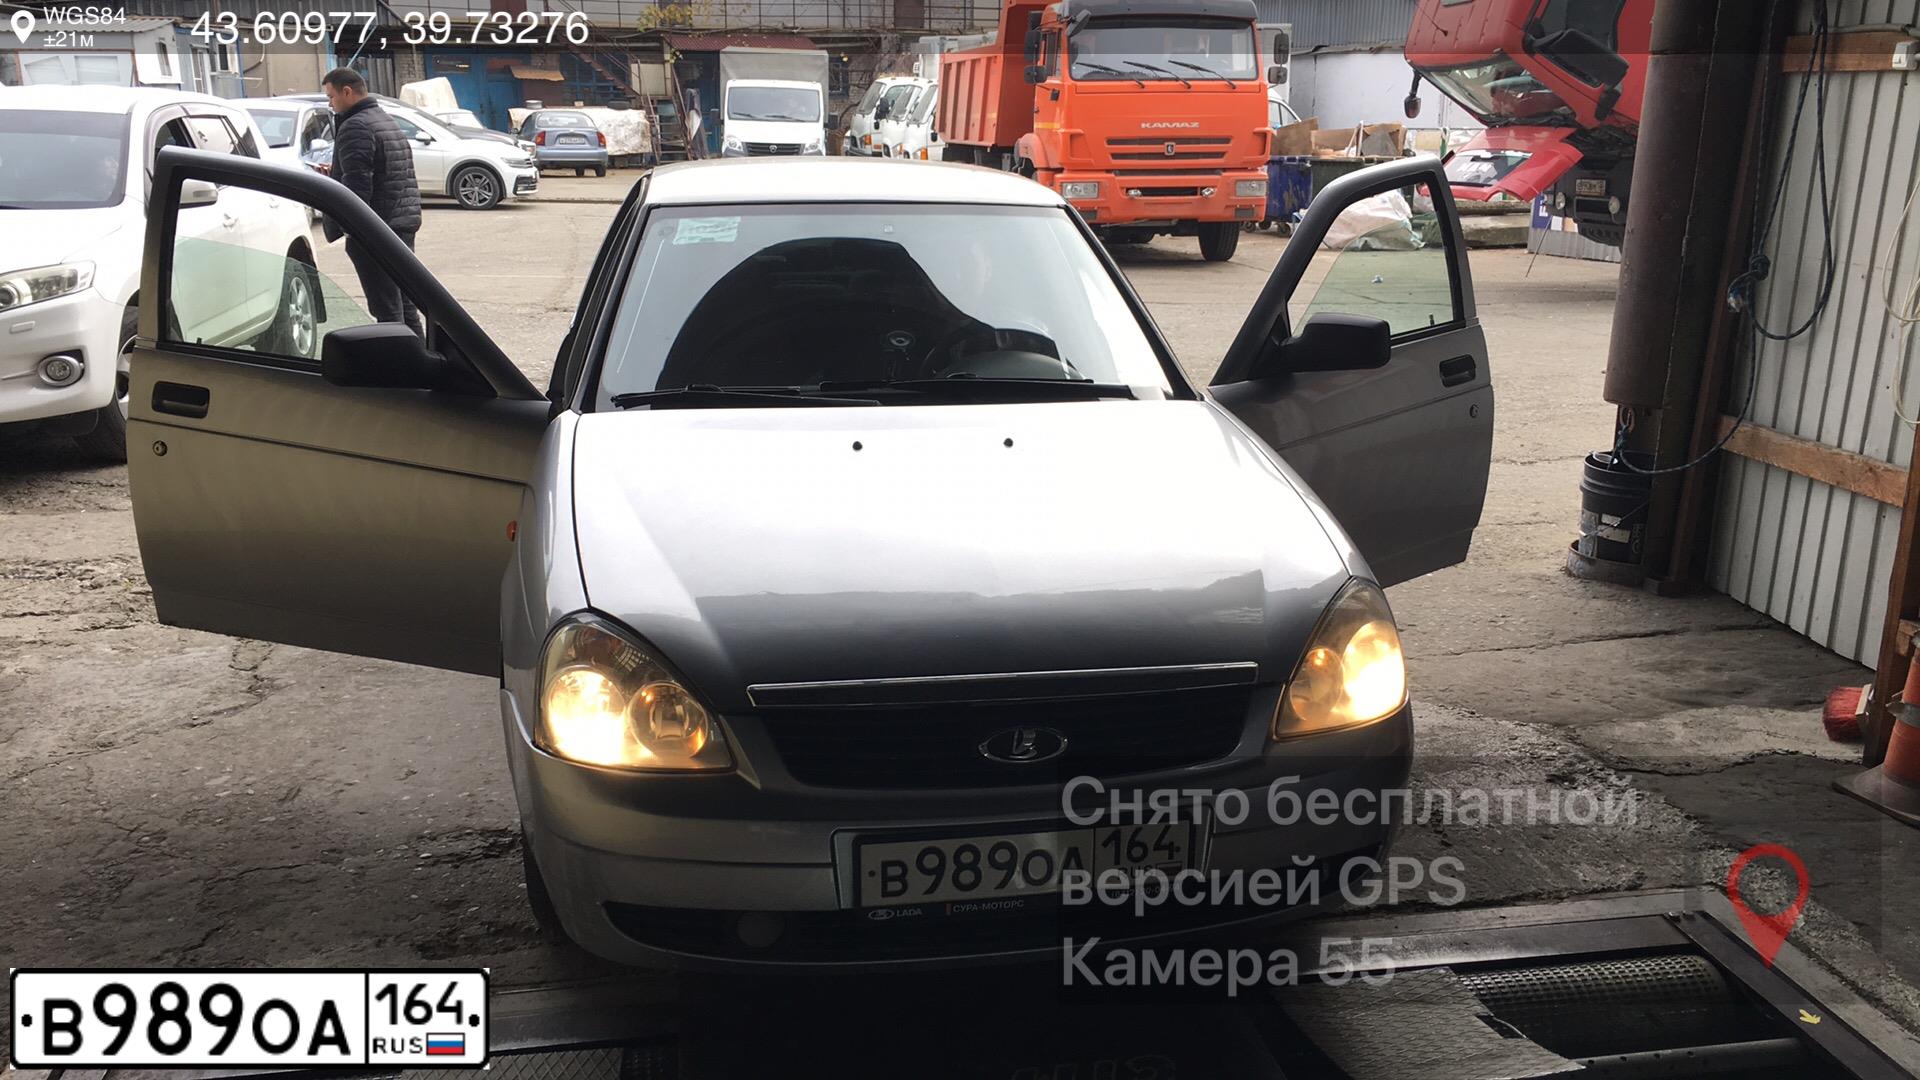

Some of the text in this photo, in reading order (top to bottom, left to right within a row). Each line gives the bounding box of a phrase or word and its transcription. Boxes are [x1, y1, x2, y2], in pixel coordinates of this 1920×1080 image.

[1141, 121, 1200, 129] KAMAZ
[1102, 825, 1175, 865] 164
[896, 907, 922, 918] LADA
[953, 899, 1025, 914] СУРА-МОТОРС
